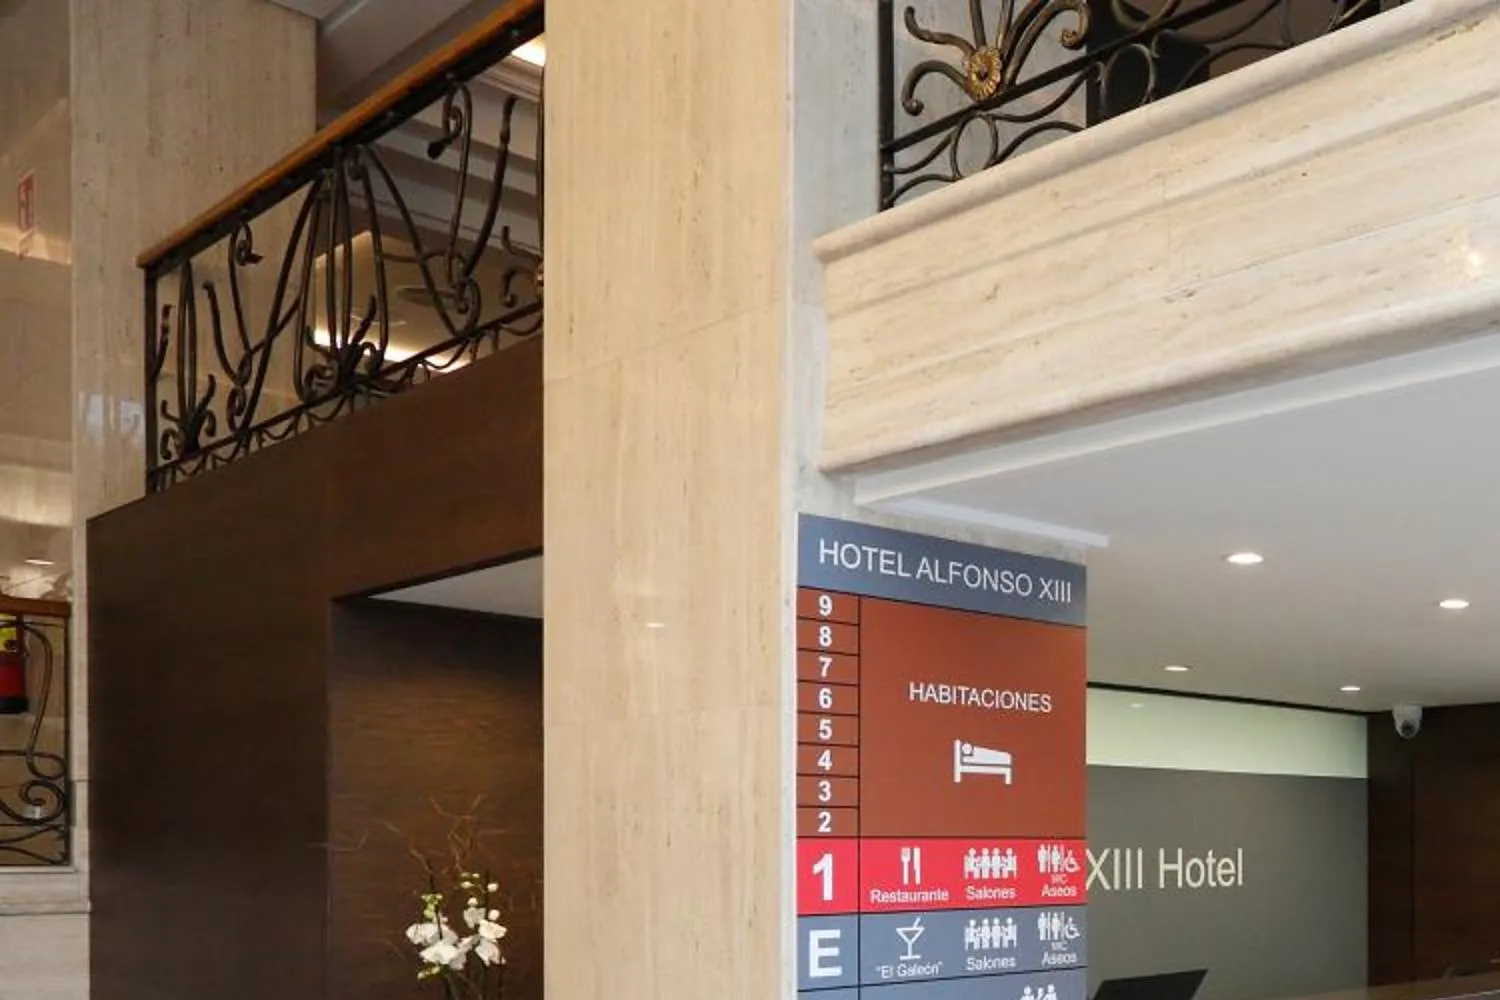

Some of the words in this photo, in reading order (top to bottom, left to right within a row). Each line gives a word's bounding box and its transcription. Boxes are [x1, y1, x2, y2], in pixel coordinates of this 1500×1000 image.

[818, 538, 912, 578] HOTEL
[916, 557, 1032, 597] ALFONSO
[1038, 576, 1072, 603] XIII
[818, 596, 832, 617] 9
[818, 626, 832, 647] 8
[818, 656, 832, 677] 7
[818, 688, 832, 709] 6
[909, 681, 1052, 713] HABITACIONES
[817, 719, 832, 740] 5
[817, 750, 832, 771] 4
[817, 781, 832, 802] 3
[817, 812, 832, 833] 2
[811, 853, 834, 901] 1
[1084, 847, 1143, 891] XIII
[1158, 847, 1243, 889] Hotel
[870, 888, 949, 904] Restaurante
[966, 885, 1017, 901] Salones
[1041, 884, 1077, 897] Aseos
[809, 929, 842, 978] E
[966, 956, 1017, 971] Salones
[1041, 951, 1078, 967] Aseos
